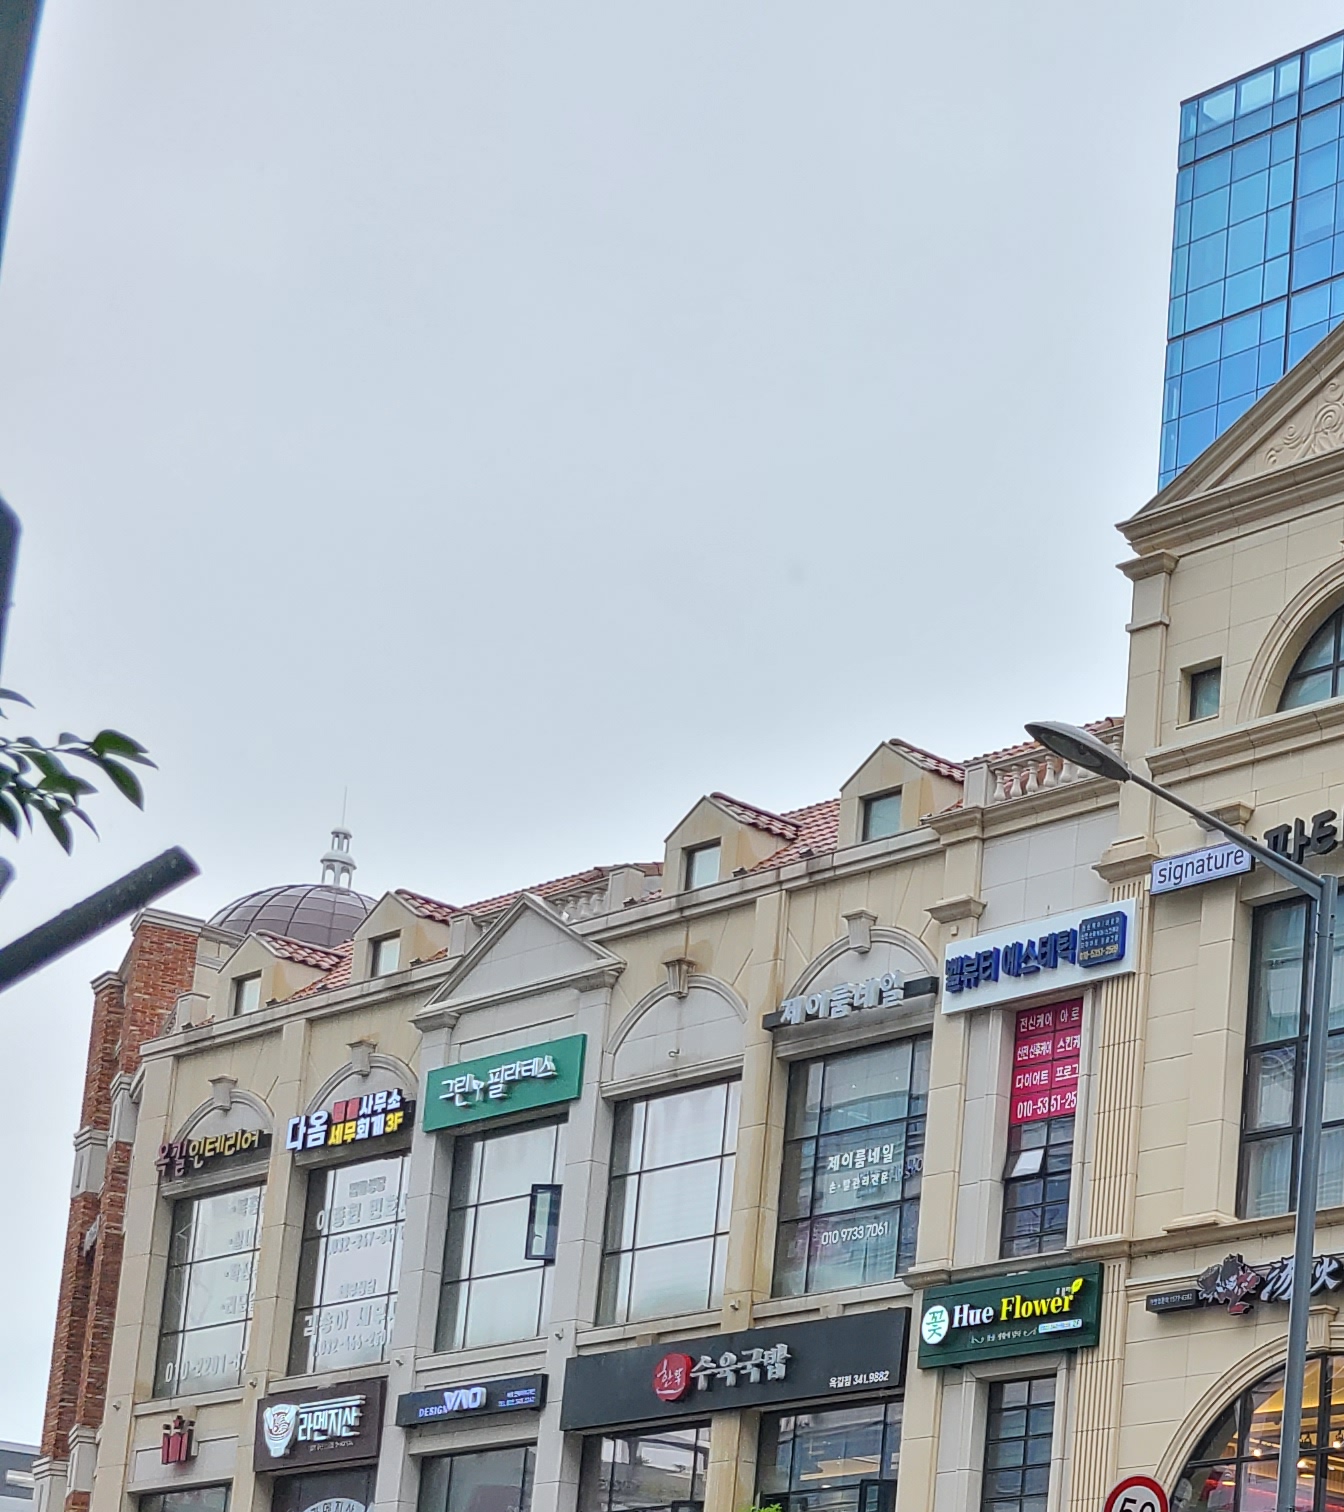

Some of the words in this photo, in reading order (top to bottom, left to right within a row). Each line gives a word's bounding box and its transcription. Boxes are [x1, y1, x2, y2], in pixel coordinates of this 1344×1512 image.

[1157, 844, 1245, 886] signature
[488, 1055, 558, 1099] 필라테스
[286, 1110, 328, 1151] 다음
[385, 1111, 404, 1133] 3F
[188, 1129, 262, 1168] 인테리어
[952, 1304, 994, 1328] Hue
[1000, 1294, 1074, 1320] Flower
[690, 1343, 792, 1391] 수육국밥
